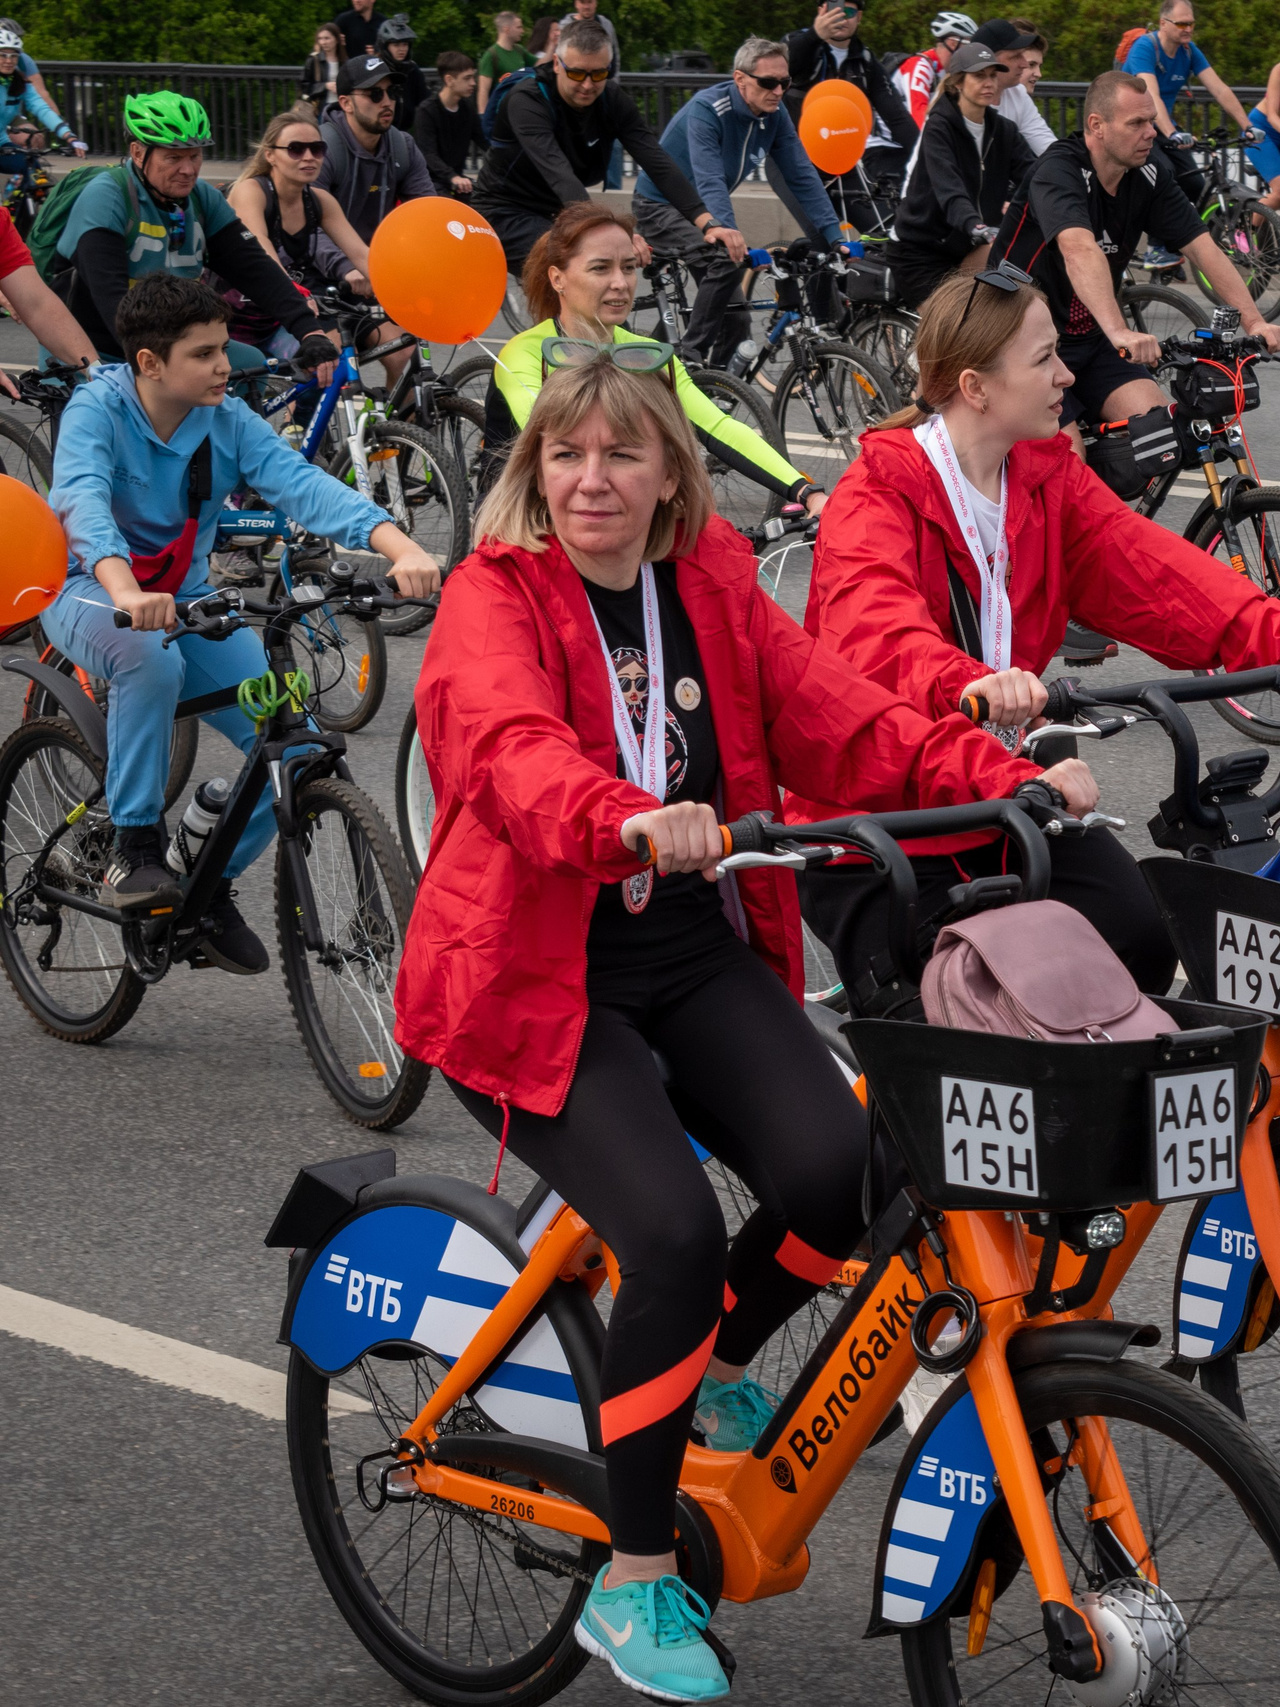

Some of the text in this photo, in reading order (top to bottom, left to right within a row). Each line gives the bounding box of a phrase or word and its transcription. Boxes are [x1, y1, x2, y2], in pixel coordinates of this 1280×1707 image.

[944, 457, 969, 519] ВЕЛОФЕСТИВАЛЬ
[237, 518, 276, 529] STERN
[996, 569, 1004, 630] ВЕЛОФЕСТИВАЛЬ
[645, 608, 657, 667] МОСКОВСКИЙ
[648, 698, 659, 768] ВЕЛОФЕСТИВАЛЬ
[946, 1083, 1029, 1135] АА6
[1158, 1079, 1231, 1132] АА6
[951, 1138, 1034, 1191] 15Н
[1163, 1135, 1233, 1187] 15Н
[1221, 1227, 1256, 1260] ВТБ
[346, 1269, 403, 1323] ВТБ
[787, 1283, 922, 1472] Велобайк
[491, 1494, 535, 1520] 26206
[940, 1466, 987, 1505] ВТБ
